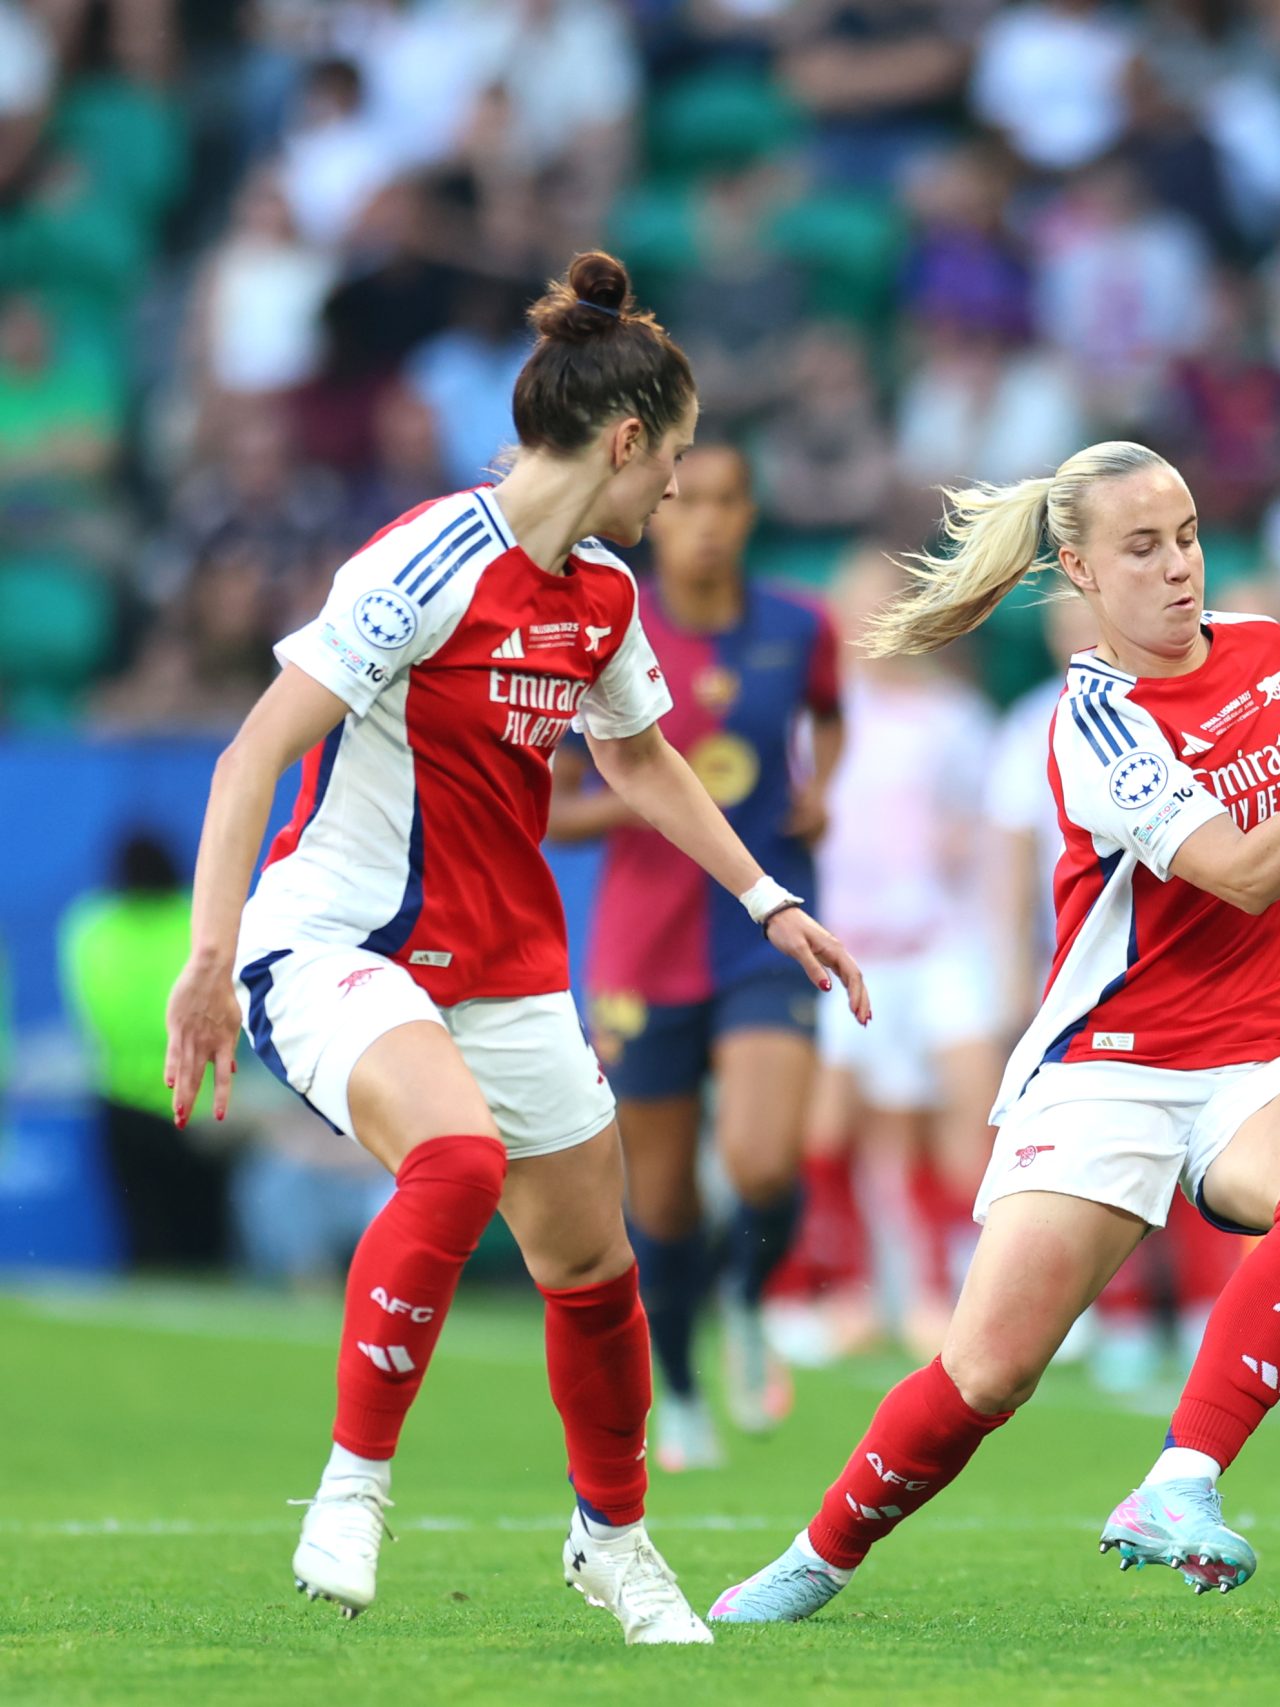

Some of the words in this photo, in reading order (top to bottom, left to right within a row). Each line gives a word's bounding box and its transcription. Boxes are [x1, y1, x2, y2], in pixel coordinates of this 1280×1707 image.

[1217, 698, 1241, 717] LISBON
[500, 711, 532, 746] FLY
[370, 1286, 434, 1323] AFC
[866, 1452, 928, 1491] AFC
